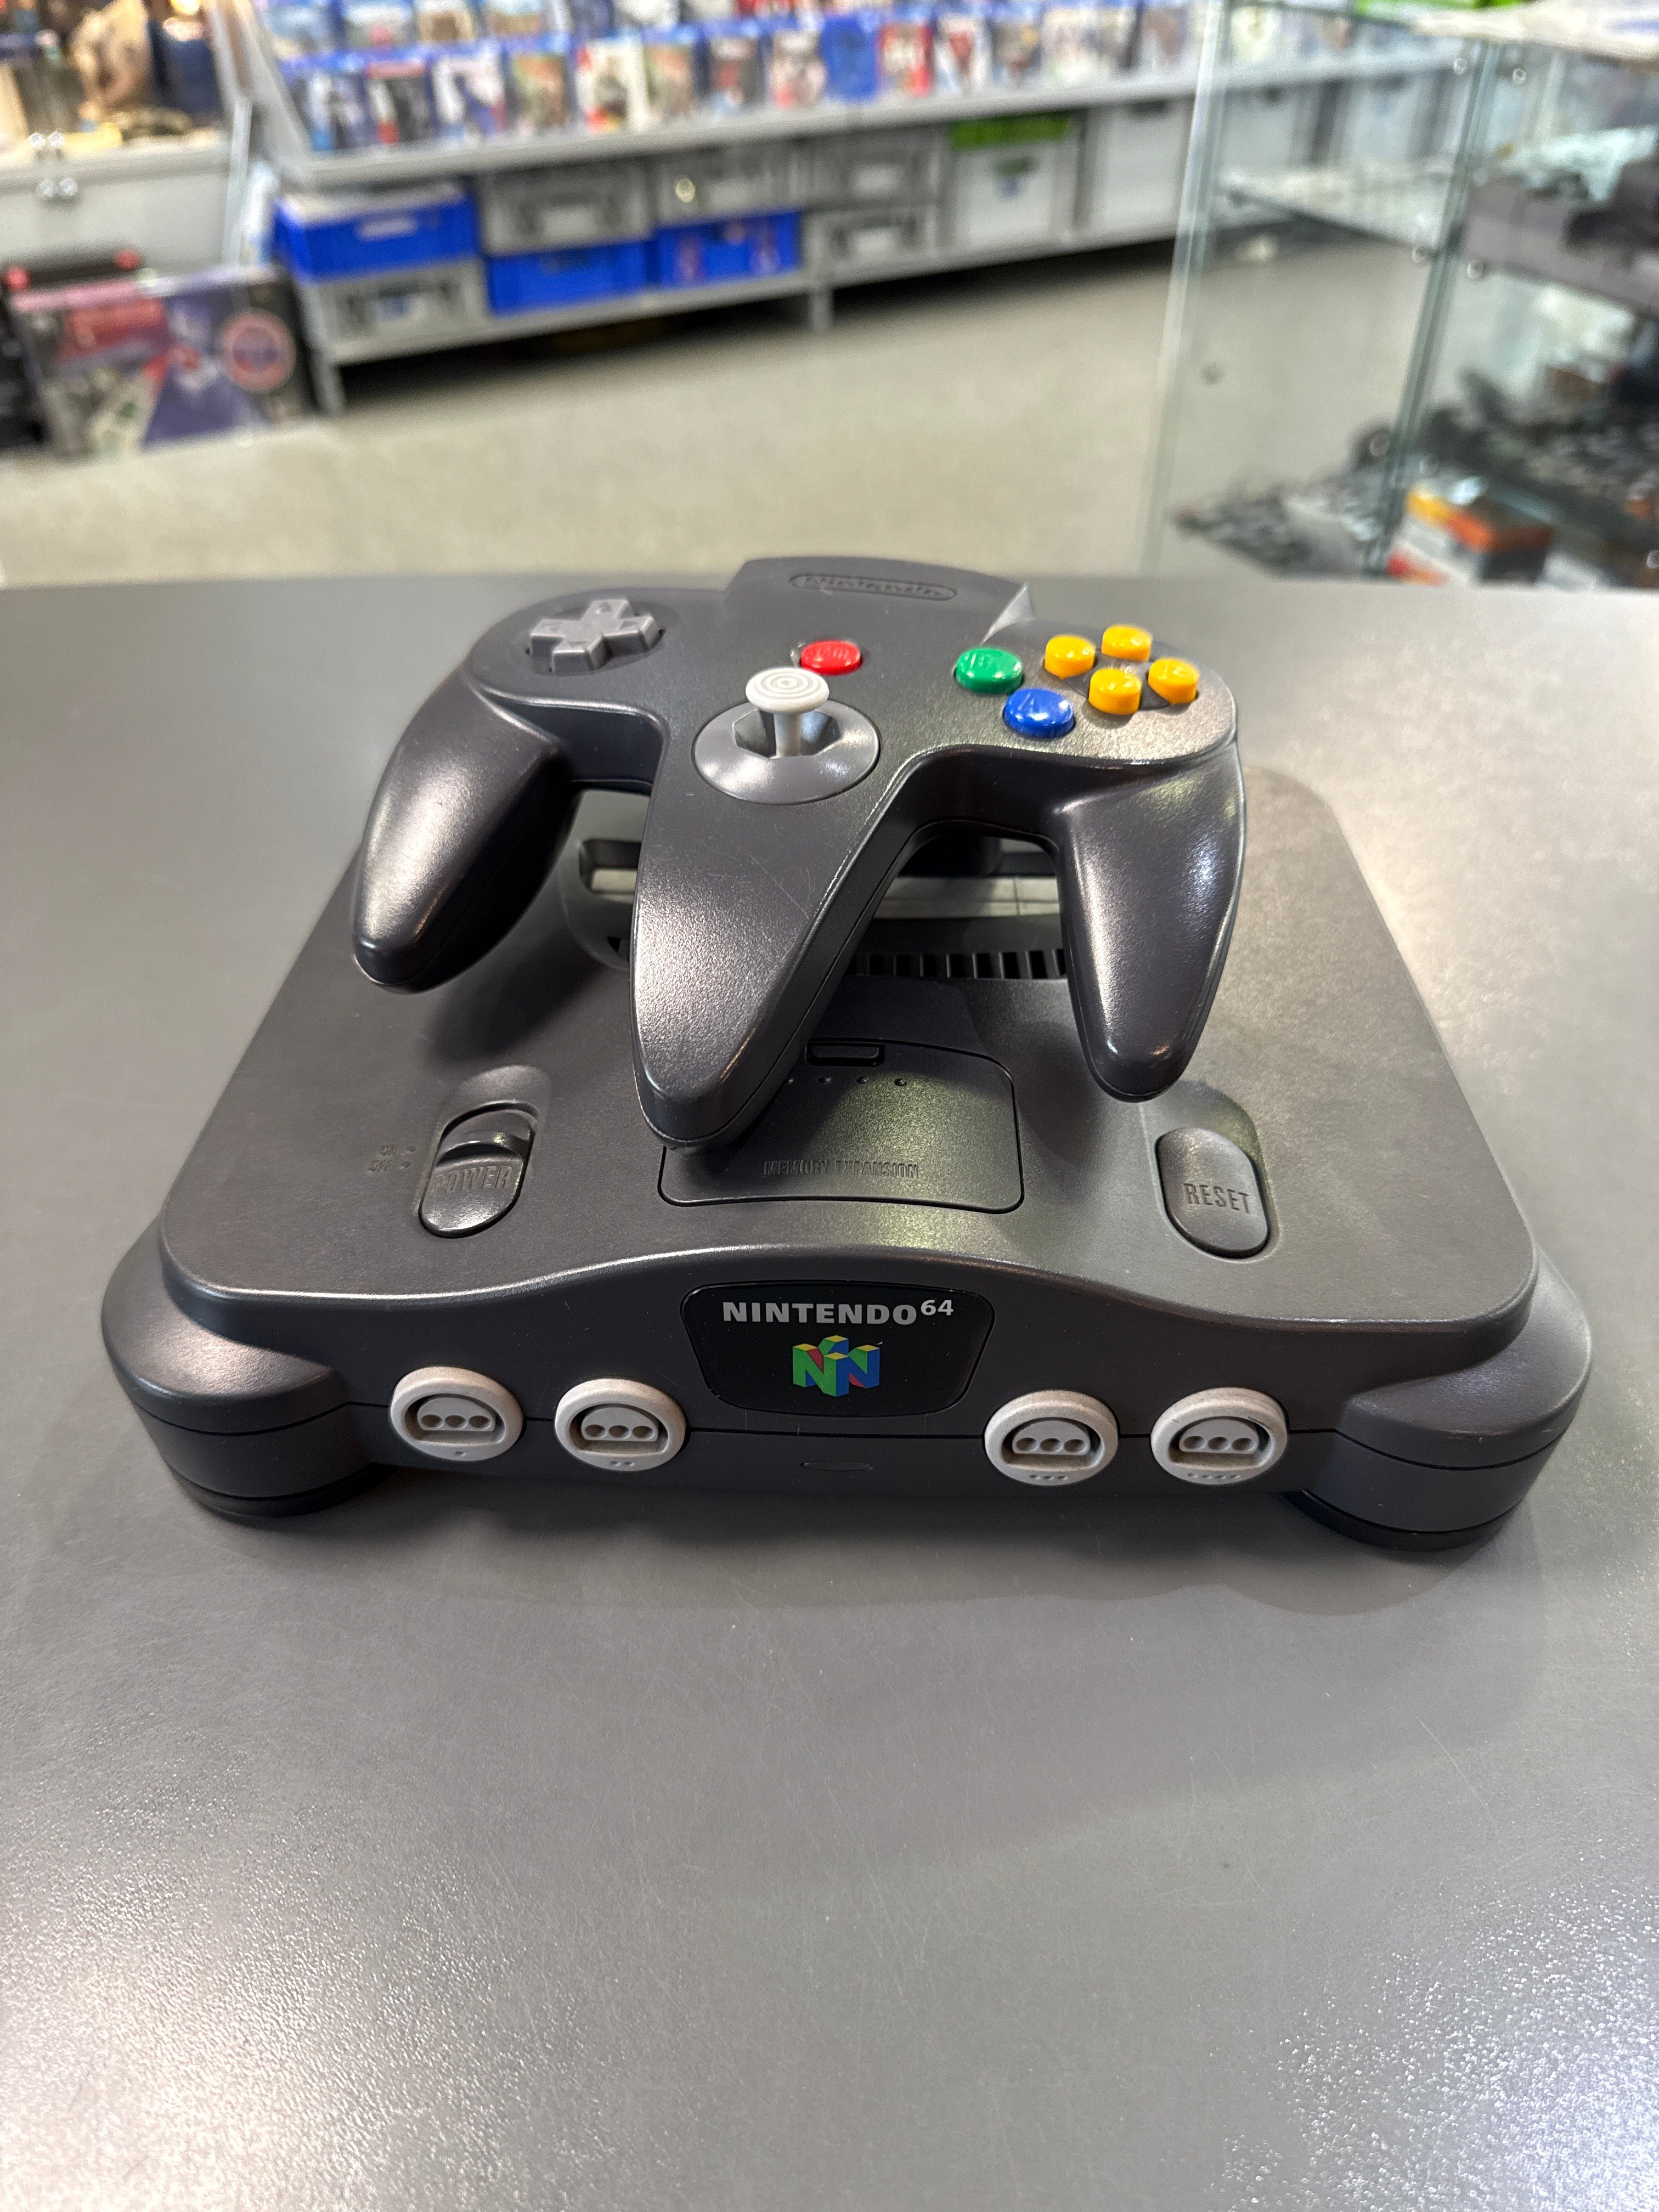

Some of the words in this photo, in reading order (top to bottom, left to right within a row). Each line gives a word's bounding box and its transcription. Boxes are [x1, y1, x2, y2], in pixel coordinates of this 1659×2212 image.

[432, 1166, 512, 1195] POWER
[833, 1160, 918, 1179] EXPANSION
[1183, 1183, 1250, 1214] RESET
[723, 1301, 917, 1325] NINTENDO
